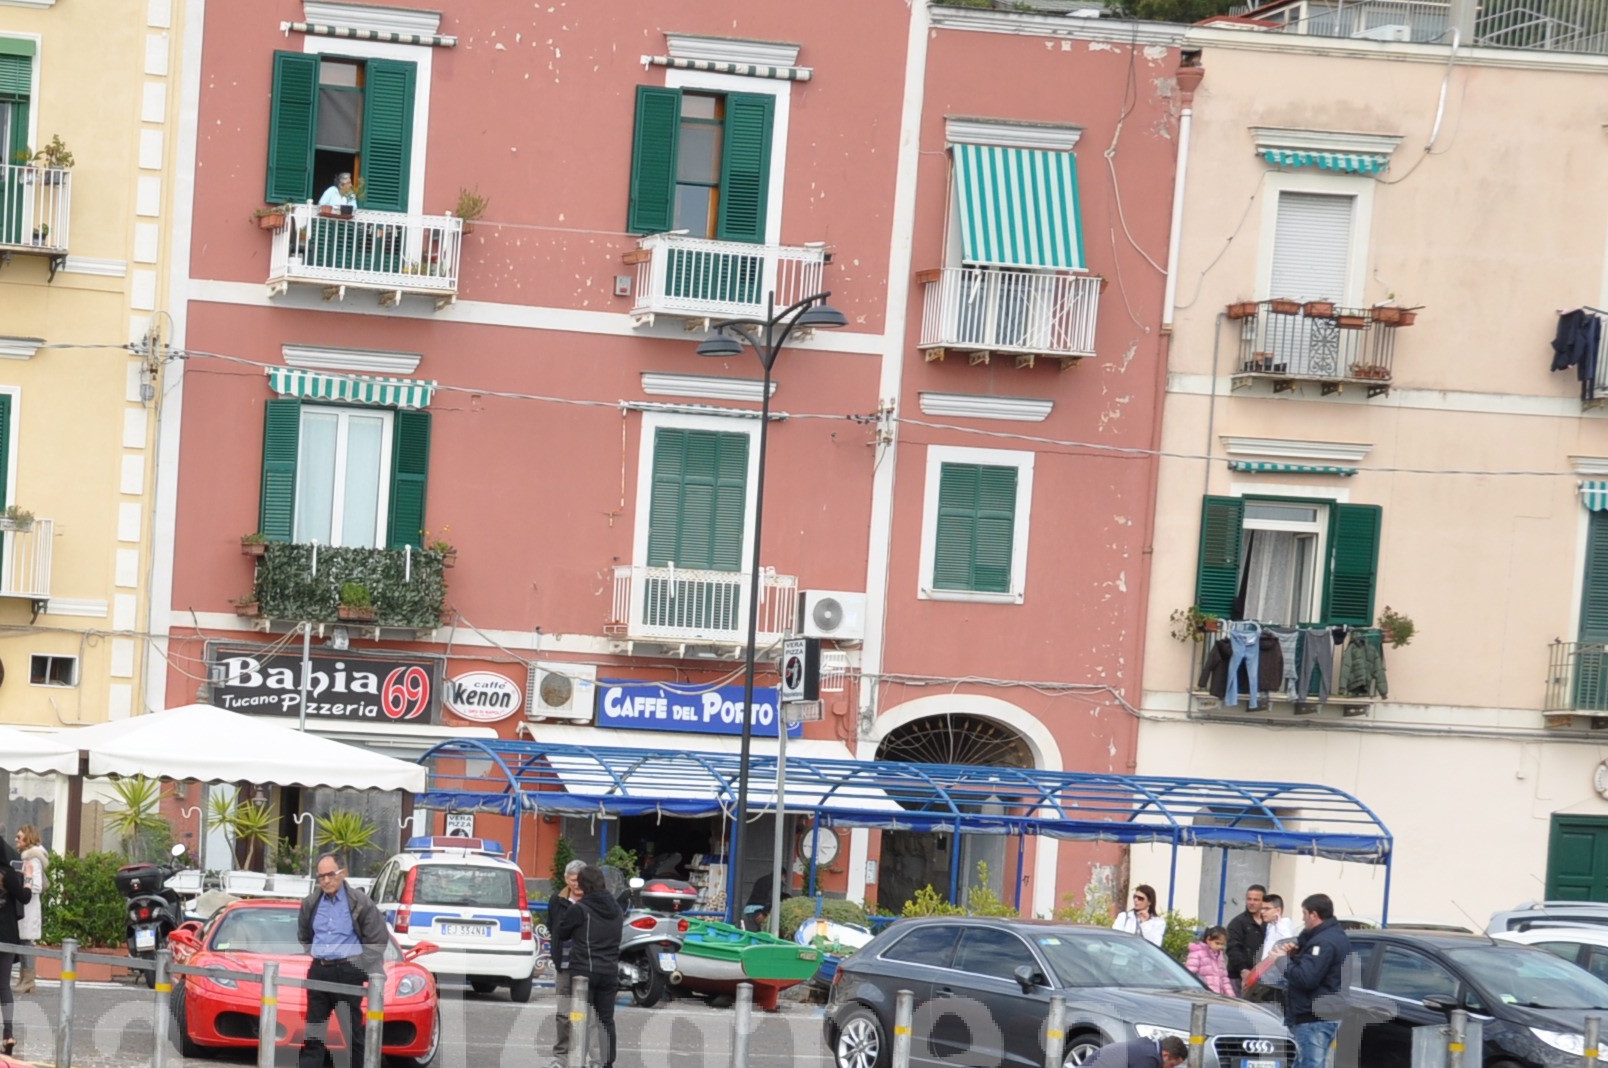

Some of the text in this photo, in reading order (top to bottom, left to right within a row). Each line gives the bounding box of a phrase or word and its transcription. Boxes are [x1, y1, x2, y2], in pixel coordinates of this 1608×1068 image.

[221, 657, 430, 720] Bahia 69
[452, 682, 512, 708] kenon
[222, 694, 378, 718] Tucano Pzzeria
[604, 688, 668, 720] CAFFÈ
[672, 704, 698, 721] DEL
[702, 692, 774, 726] PORTO
